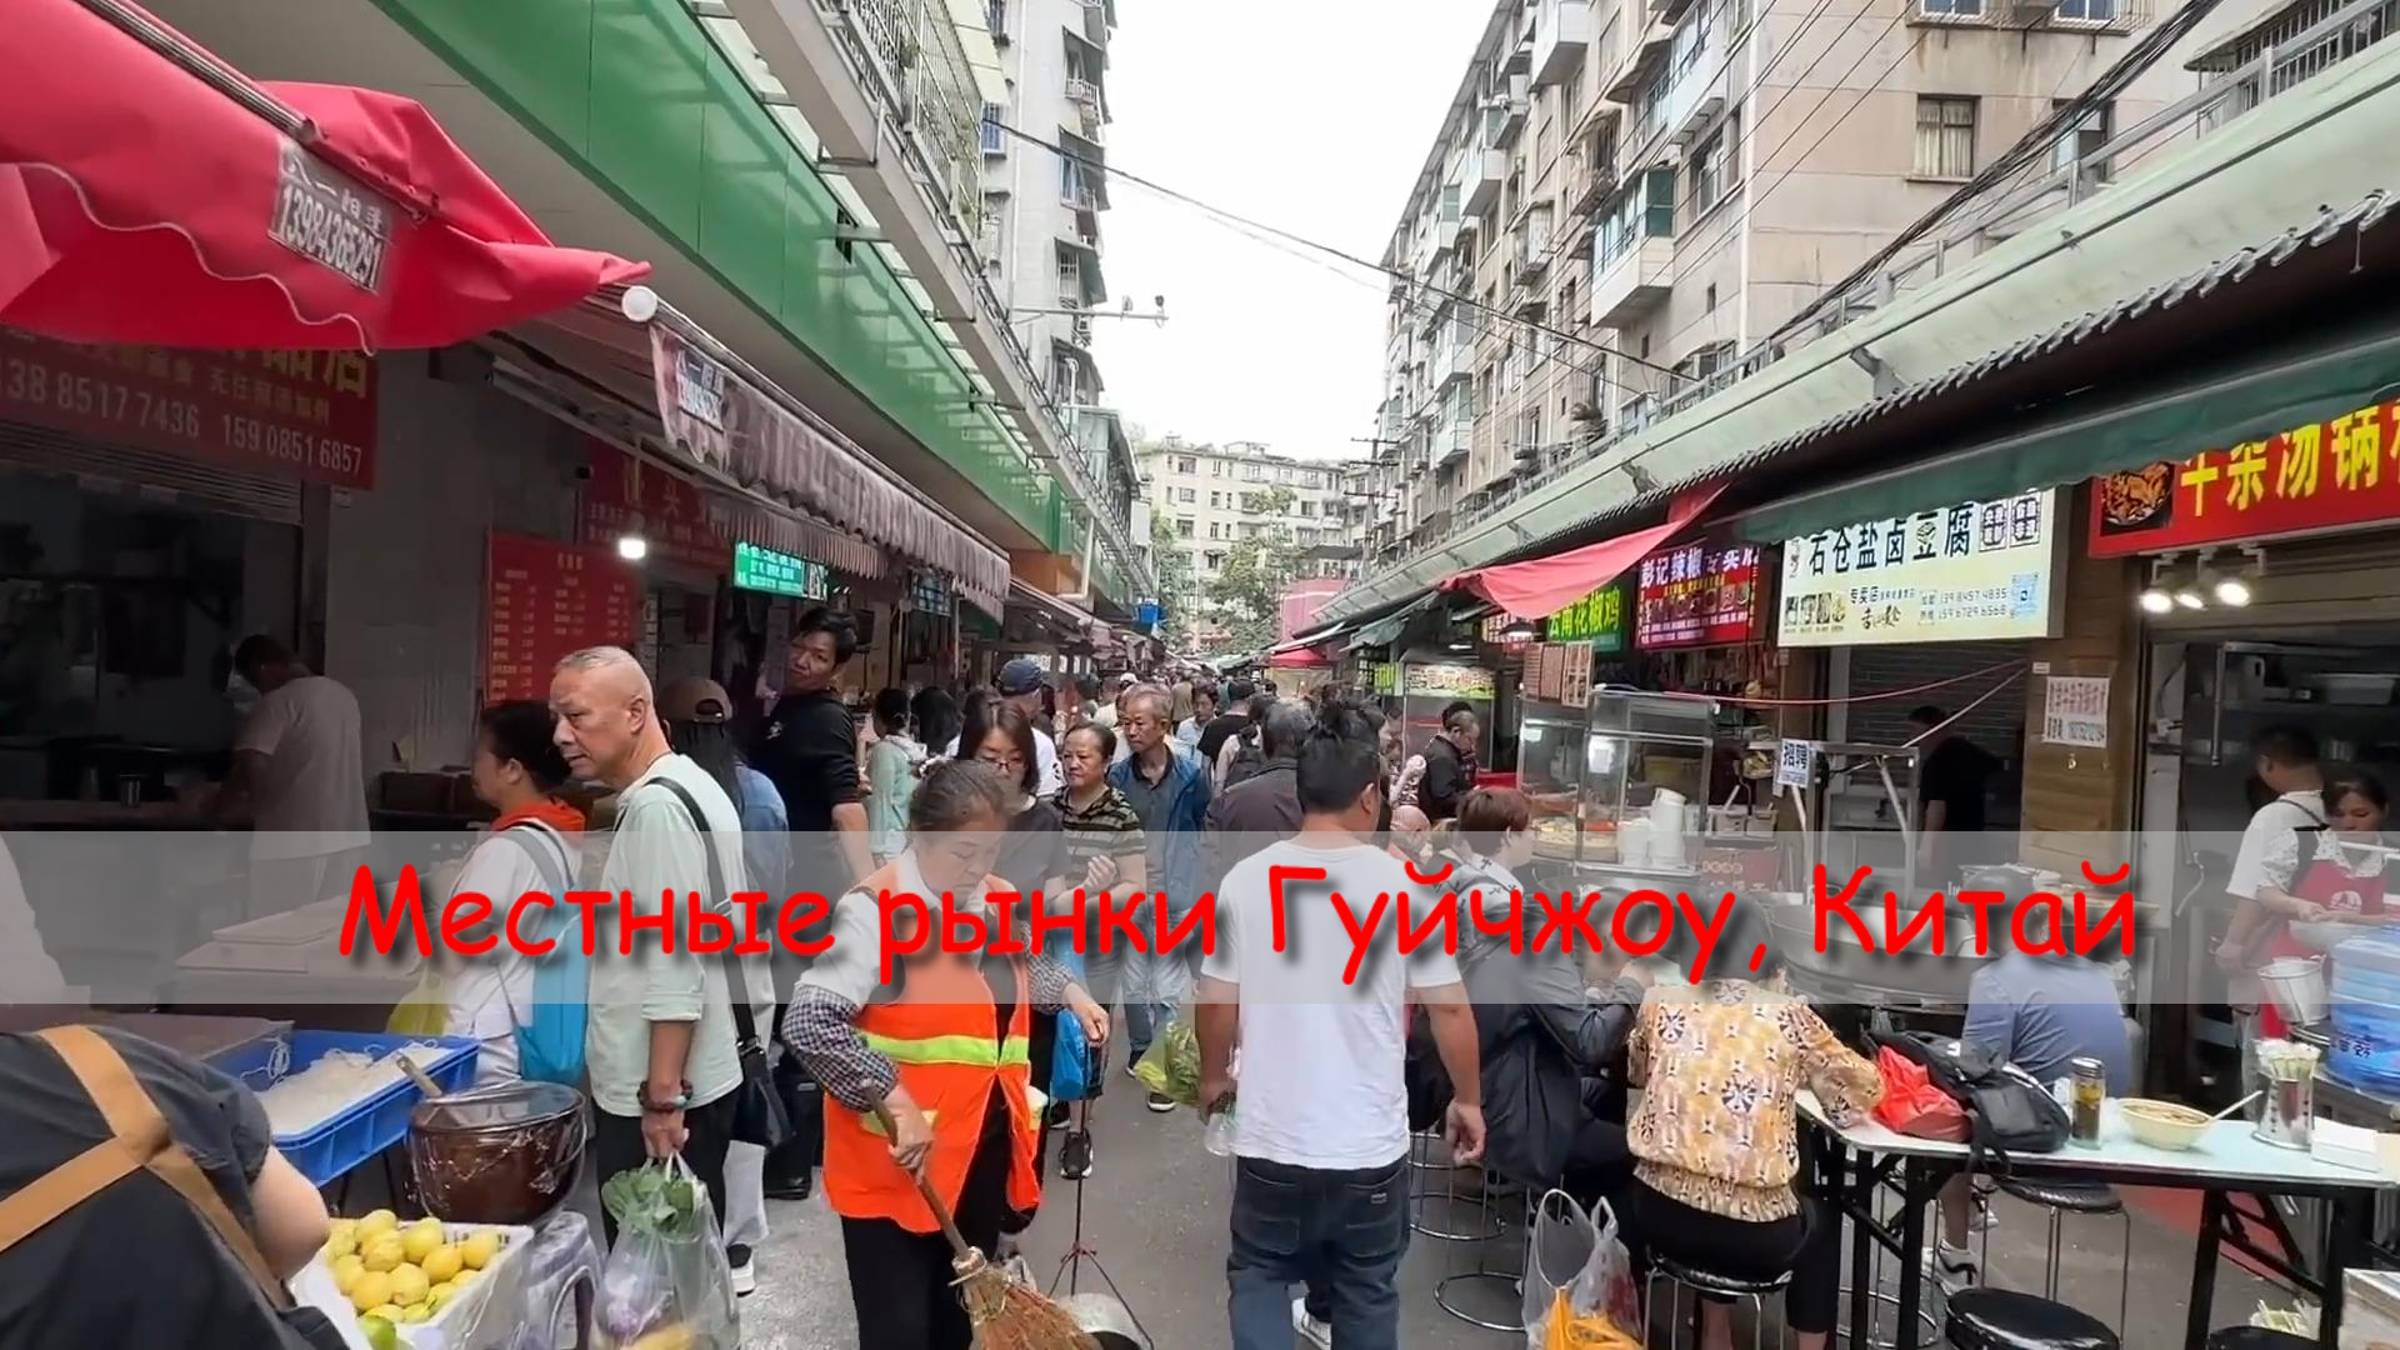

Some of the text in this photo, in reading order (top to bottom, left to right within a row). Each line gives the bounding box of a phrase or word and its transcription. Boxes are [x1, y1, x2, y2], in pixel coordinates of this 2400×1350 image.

[0, 355, 200, 440] 38 8517 7436
[223, 414, 363, 475] 159 0851 6857
[2181, 402, 2400, 517] 牛杂汤锅
[1809, 503, 1975, 577] 石仓盐卤豆腐
